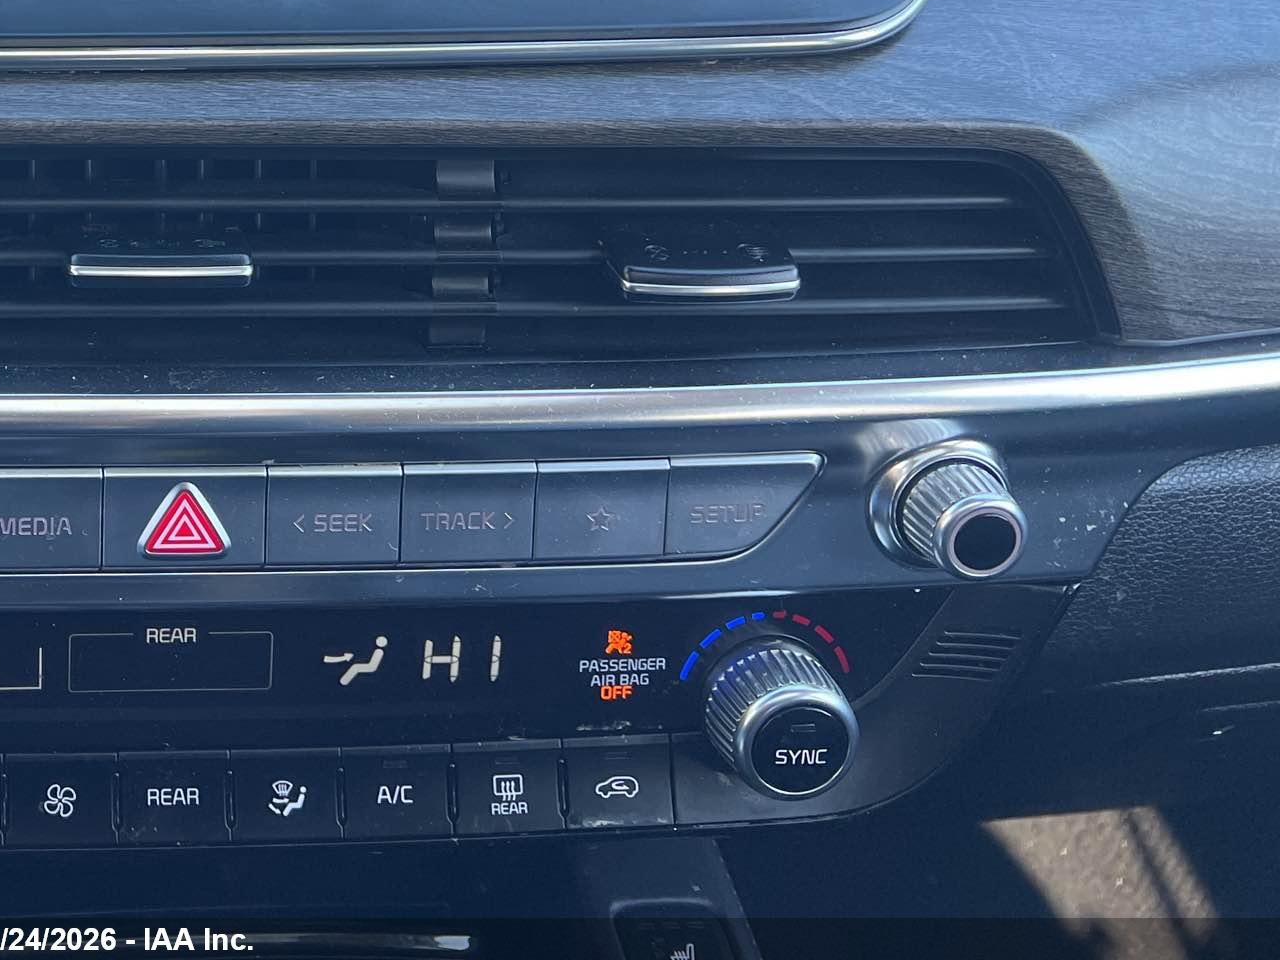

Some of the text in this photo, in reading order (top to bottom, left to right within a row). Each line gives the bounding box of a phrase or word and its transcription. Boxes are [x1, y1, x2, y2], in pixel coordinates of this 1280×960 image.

[420, 511, 496, 531] TRACK
[688, 503, 765, 525] SETUP
[313, 513, 373, 533] SEEK
[146, 627, 197, 644] REAR
[579, 657, 666, 673] PASSENGER
[590, 673, 649, 687] AIR BAG
[600, 685, 633, 700] OFF
[775, 748, 828, 765] SYNC
[147, 788, 200, 806] REAR
[376, 785, 414, 804] A/C
[490, 801, 529, 816] REAR
